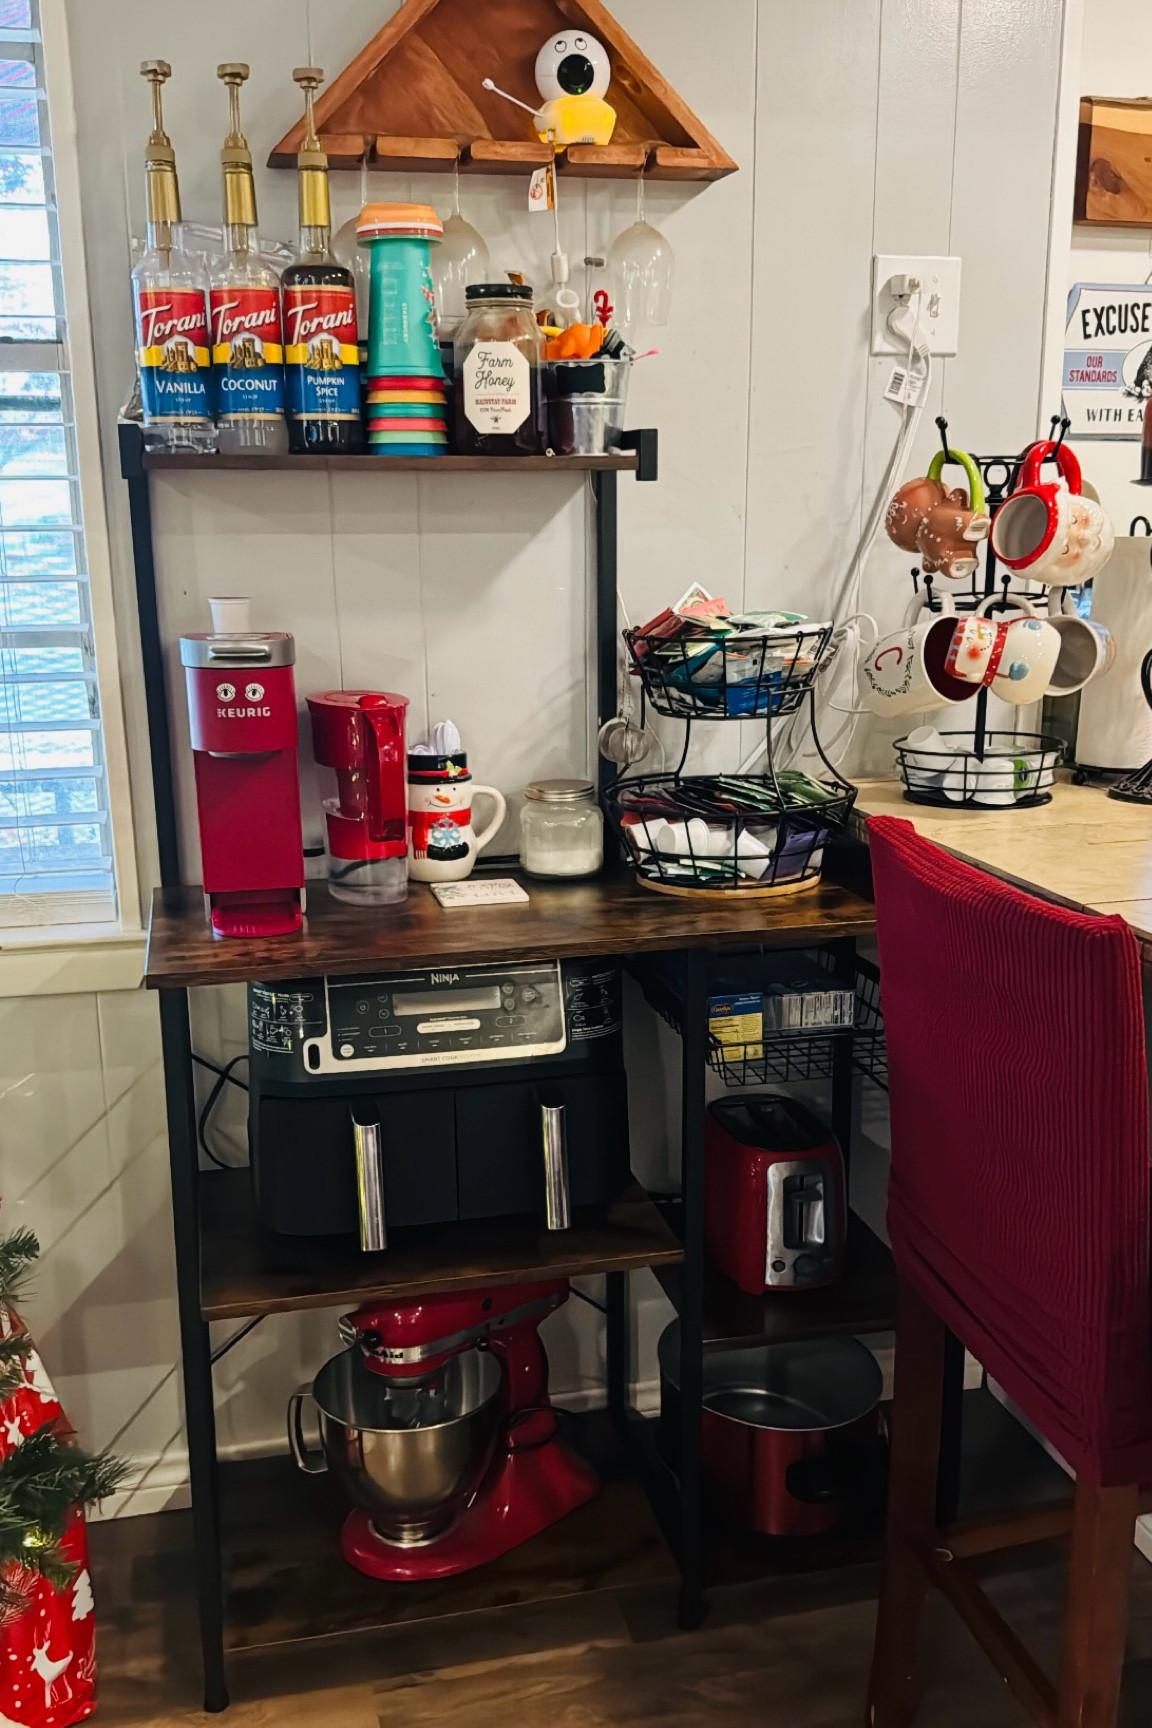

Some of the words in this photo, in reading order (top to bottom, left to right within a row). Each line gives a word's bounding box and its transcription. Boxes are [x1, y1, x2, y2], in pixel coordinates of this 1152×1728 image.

[141, 303, 206, 349] Torani
[211, 301, 276, 347] Torani
[287, 301, 354, 347] Torani
[1081, 302, 1152, 340] EXCUSE
[477, 351, 514, 370] Farm
[1086, 355, 1103, 369] OUR
[221, 376, 278, 391] COCONUT
[306, 374, 345, 386] PUMPKIN
[474, 370, 516, 392] Honey
[1068, 369, 1118, 383] STANDARDS
[155, 379, 206, 395] VANILLA
[315, 385, 338, 397] SPICE
[1086, 408, 1122, 422] WITH
[1127, 408, 1144, 422] EA
[216, 706, 271, 718] KEURIG
[431, 973, 460, 985] NINJA
